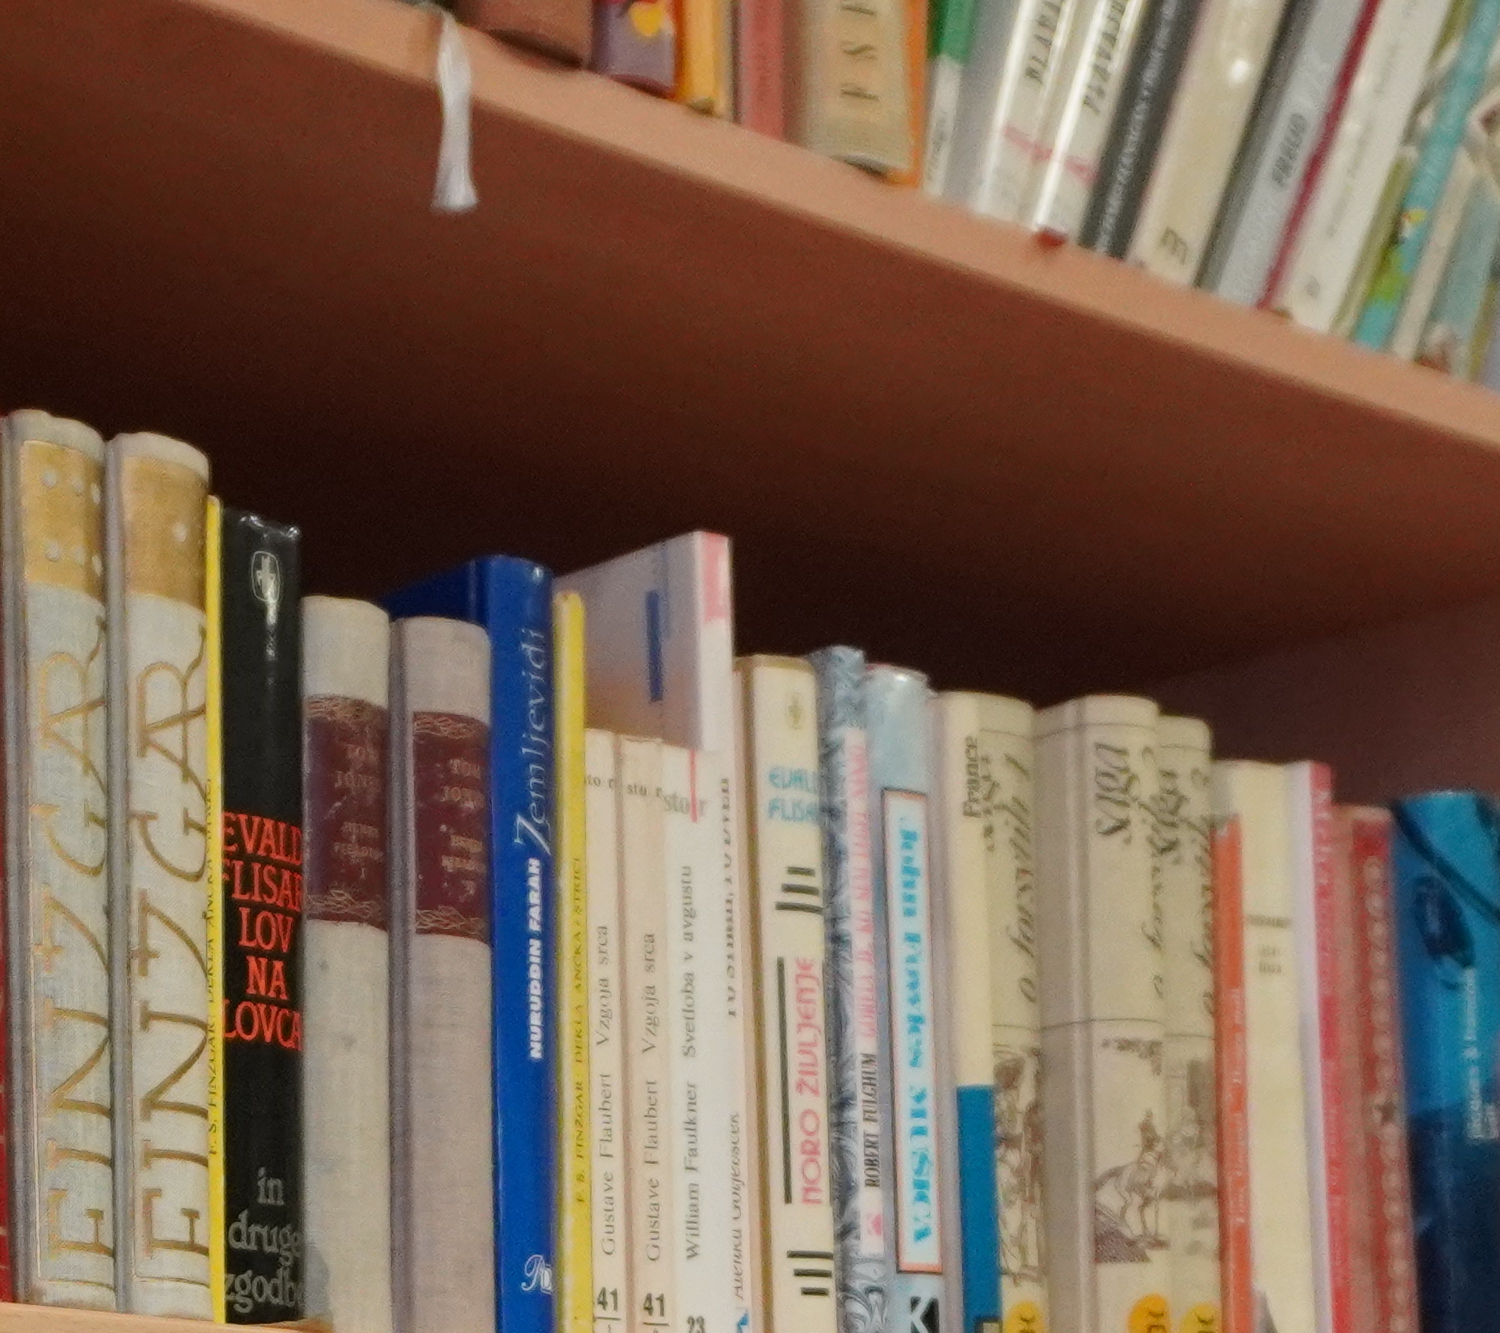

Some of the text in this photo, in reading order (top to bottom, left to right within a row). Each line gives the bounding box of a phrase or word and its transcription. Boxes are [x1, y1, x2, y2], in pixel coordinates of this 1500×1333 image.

[513, 628, 552, 856] Zemljevidi
[526, 857, 544, 1060] NURUDDIN FARAH
[862, 1131, 879, 1188] ROBERT
